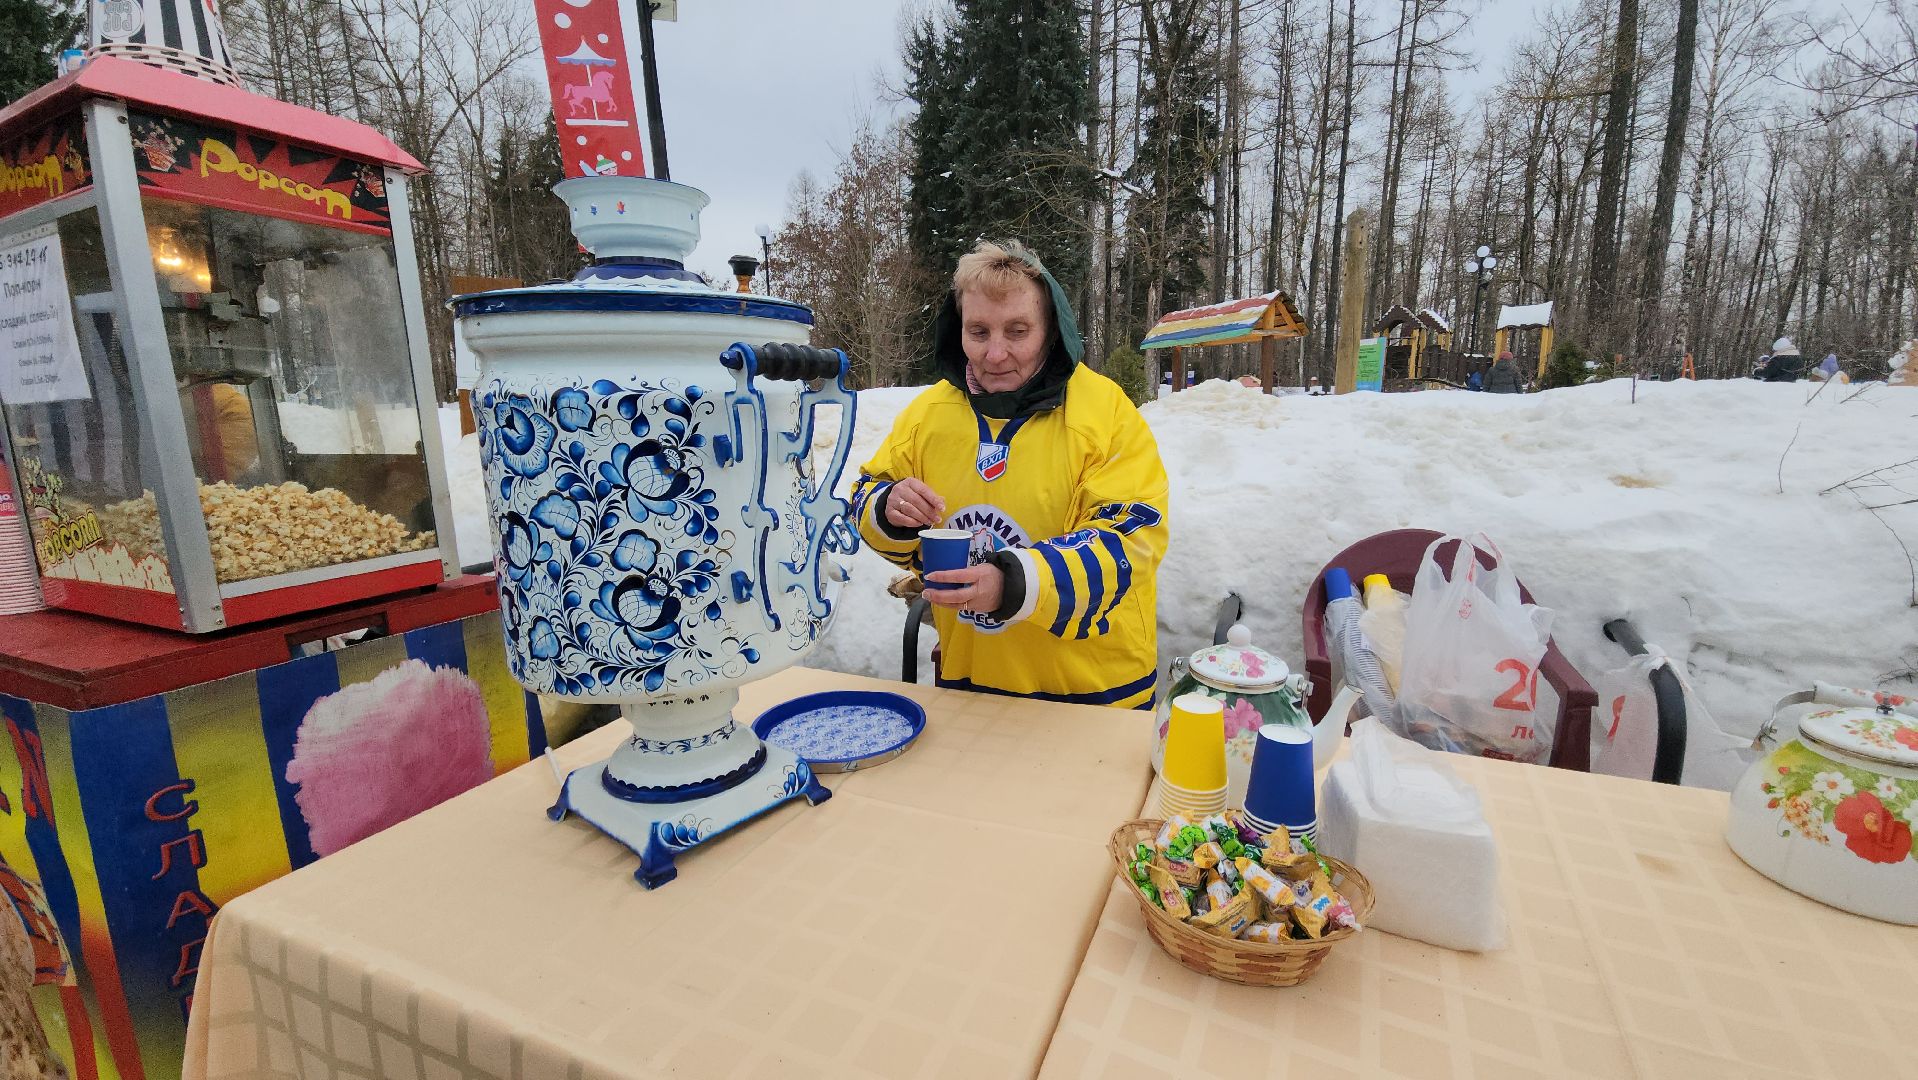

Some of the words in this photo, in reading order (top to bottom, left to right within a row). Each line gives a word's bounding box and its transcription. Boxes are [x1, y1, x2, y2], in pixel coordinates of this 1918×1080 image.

[102, 13, 132, 32] POP
[200, 137, 352, 220] Popcorn
[981, 451, 1004, 469] ВХЛ
[1493, 658, 1537, 711] 2
